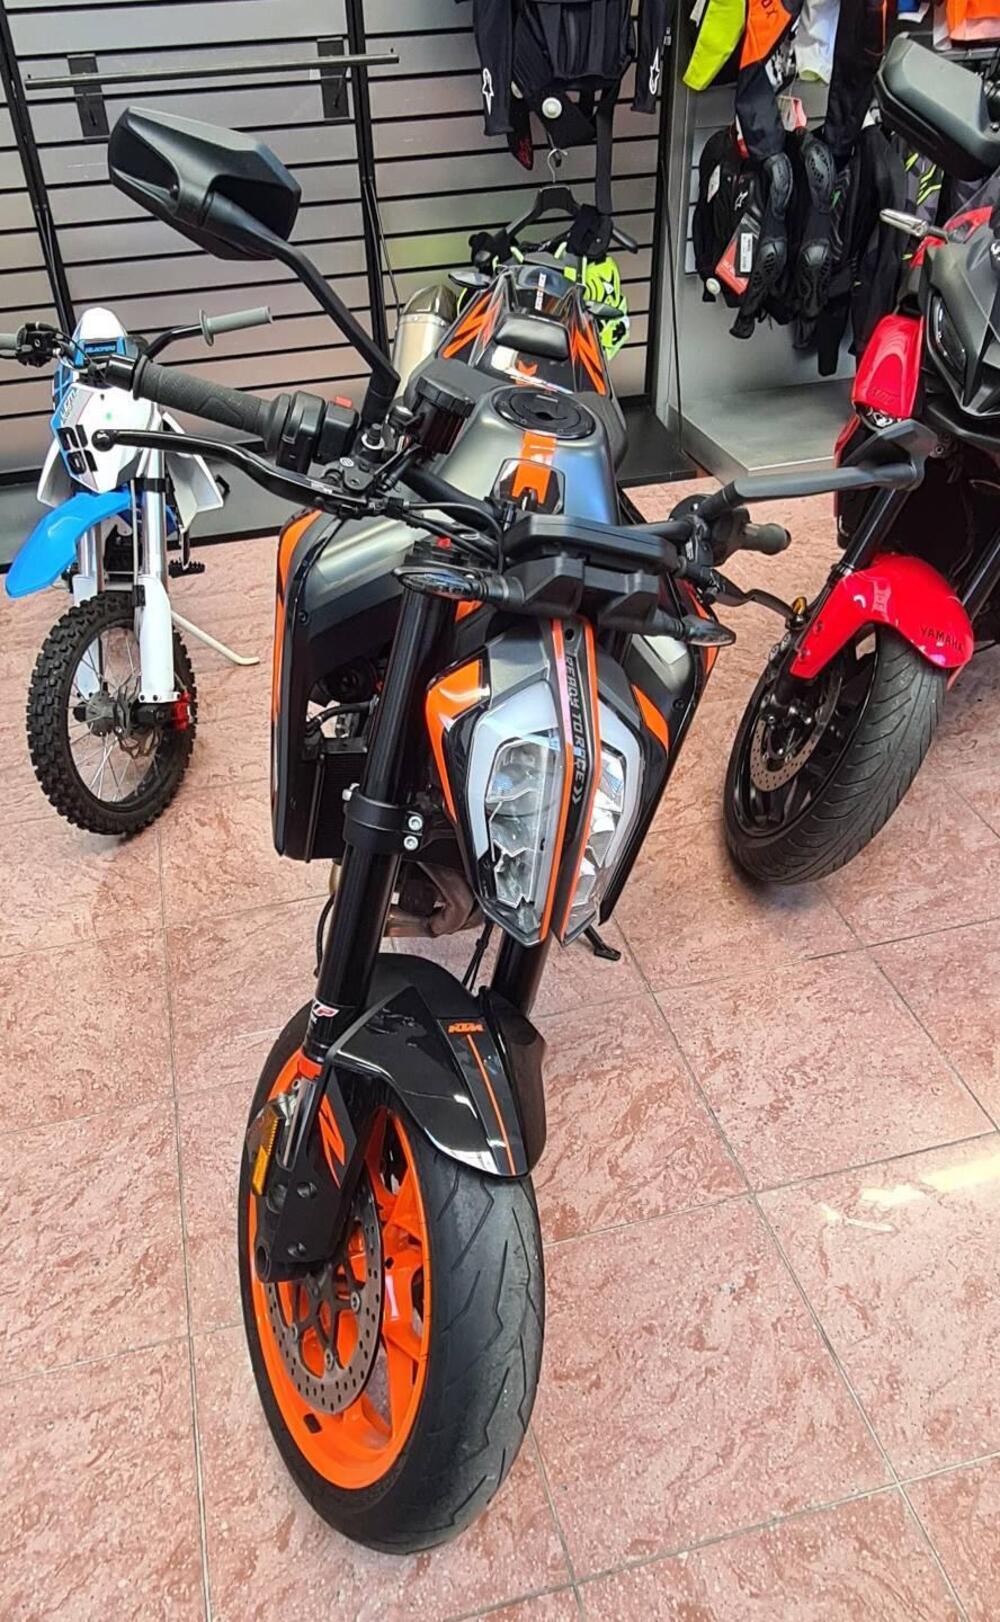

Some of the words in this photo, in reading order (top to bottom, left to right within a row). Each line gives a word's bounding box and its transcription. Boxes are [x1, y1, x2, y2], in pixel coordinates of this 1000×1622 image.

[919, 624, 964, 652] YAMAHA
[566, 656, 580, 706] READY
[571, 712, 583, 733] TO
[573, 735, 586, 784] RACE
[448, 1022, 484, 1034] KTM
